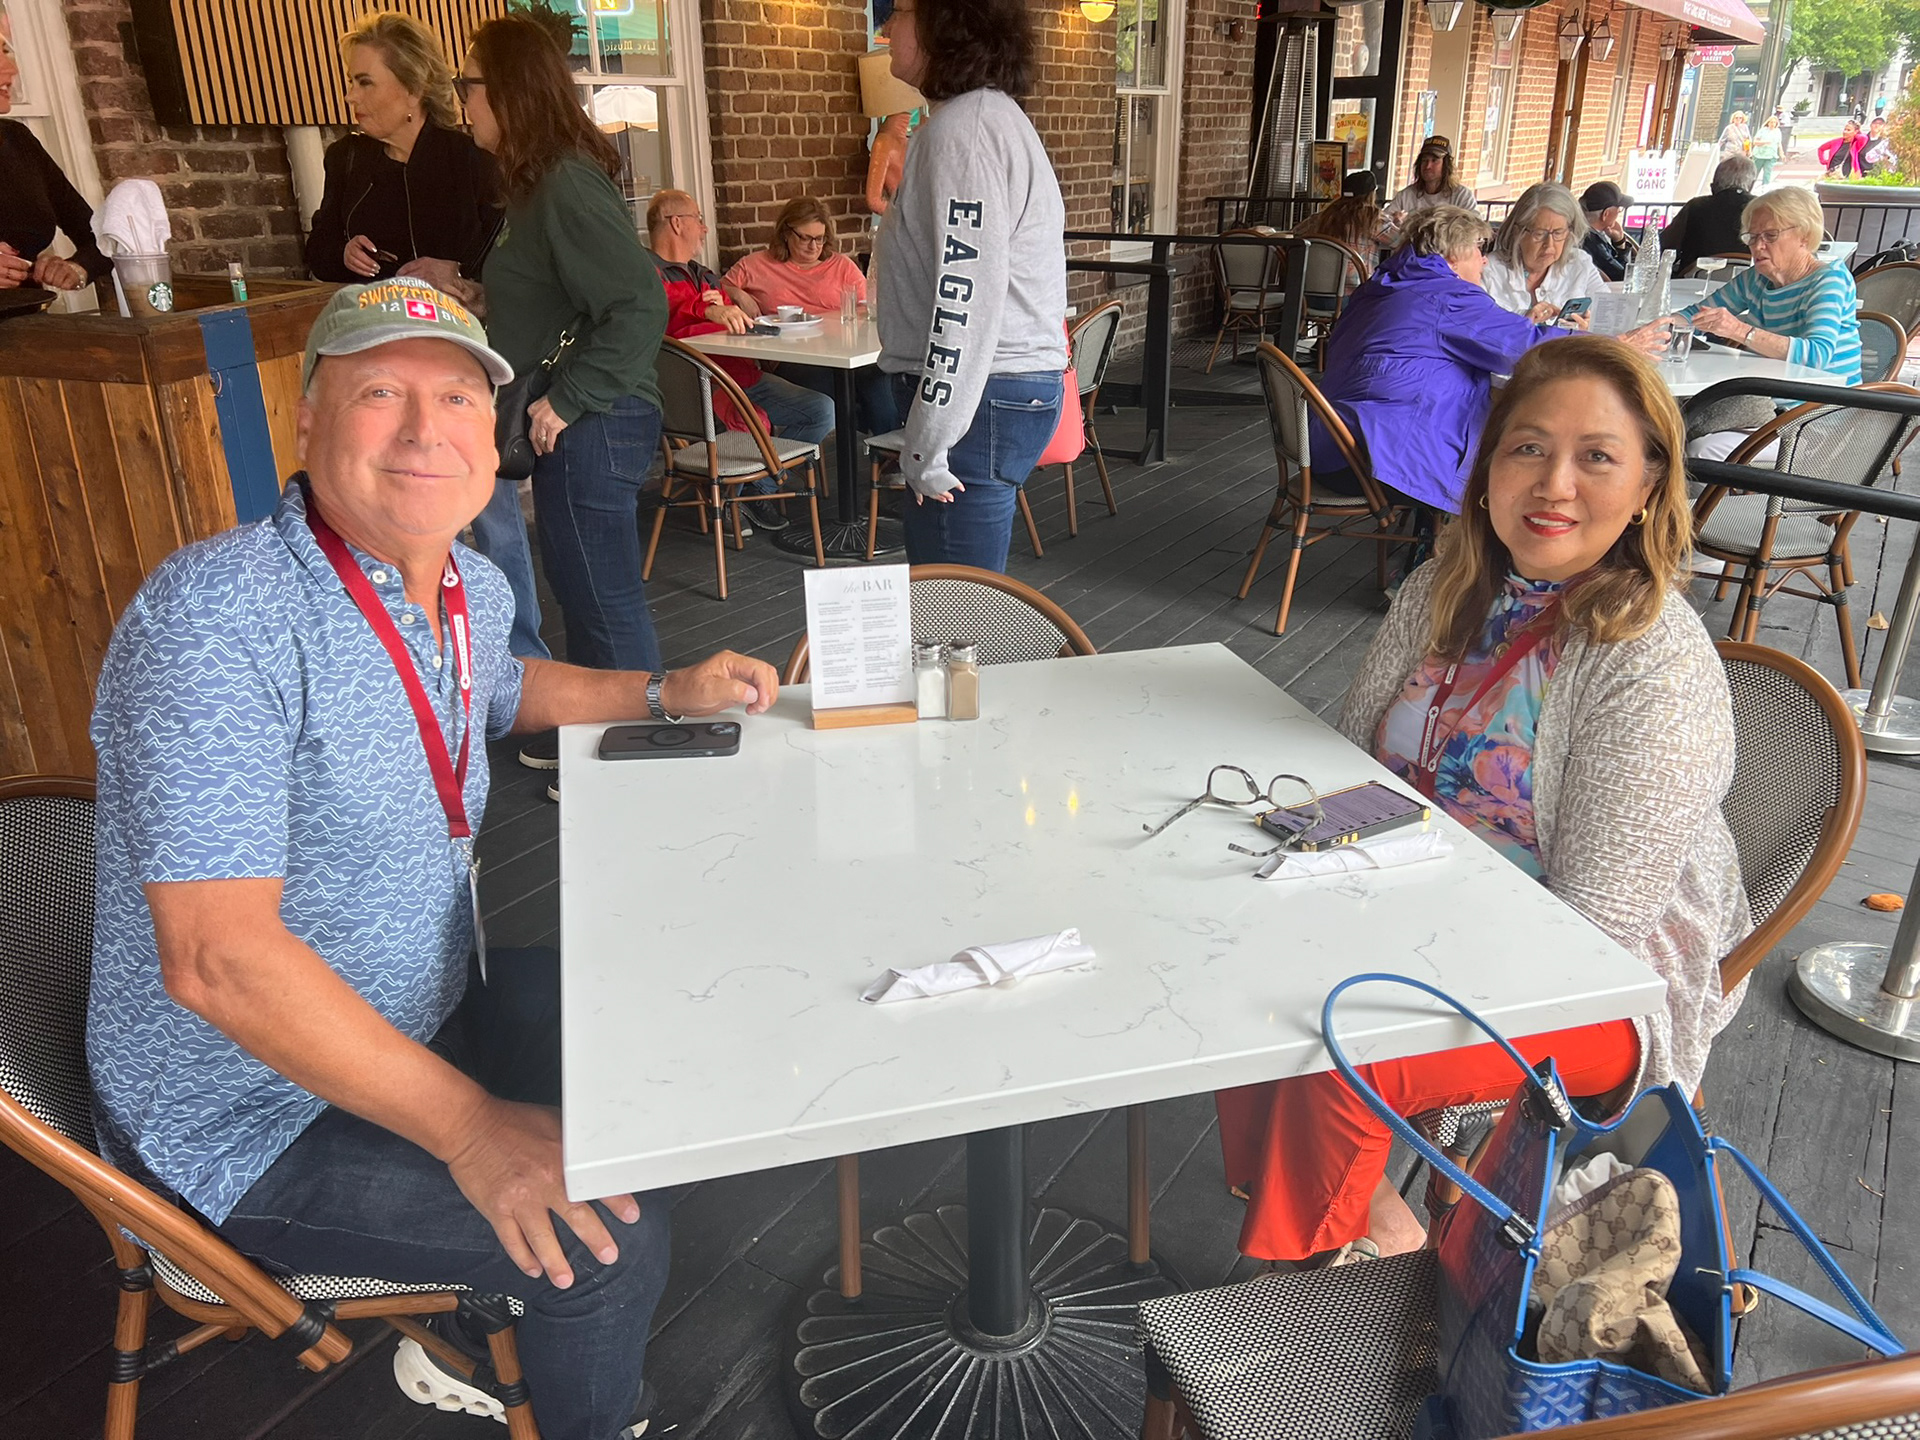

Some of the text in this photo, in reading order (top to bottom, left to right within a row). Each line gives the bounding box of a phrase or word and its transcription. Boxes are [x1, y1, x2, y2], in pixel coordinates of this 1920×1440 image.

[1336, 120, 1356, 129] DRINK
[1637, 168, 1667, 177] WOOF
[1636, 179, 1666, 189] GANG
[358, 284, 471, 328] SWITZERLAND
[920, 197, 984, 407] EAGLES
[842, 579, 892, 593] the BAR
[455, 618, 463, 638] TOURS
